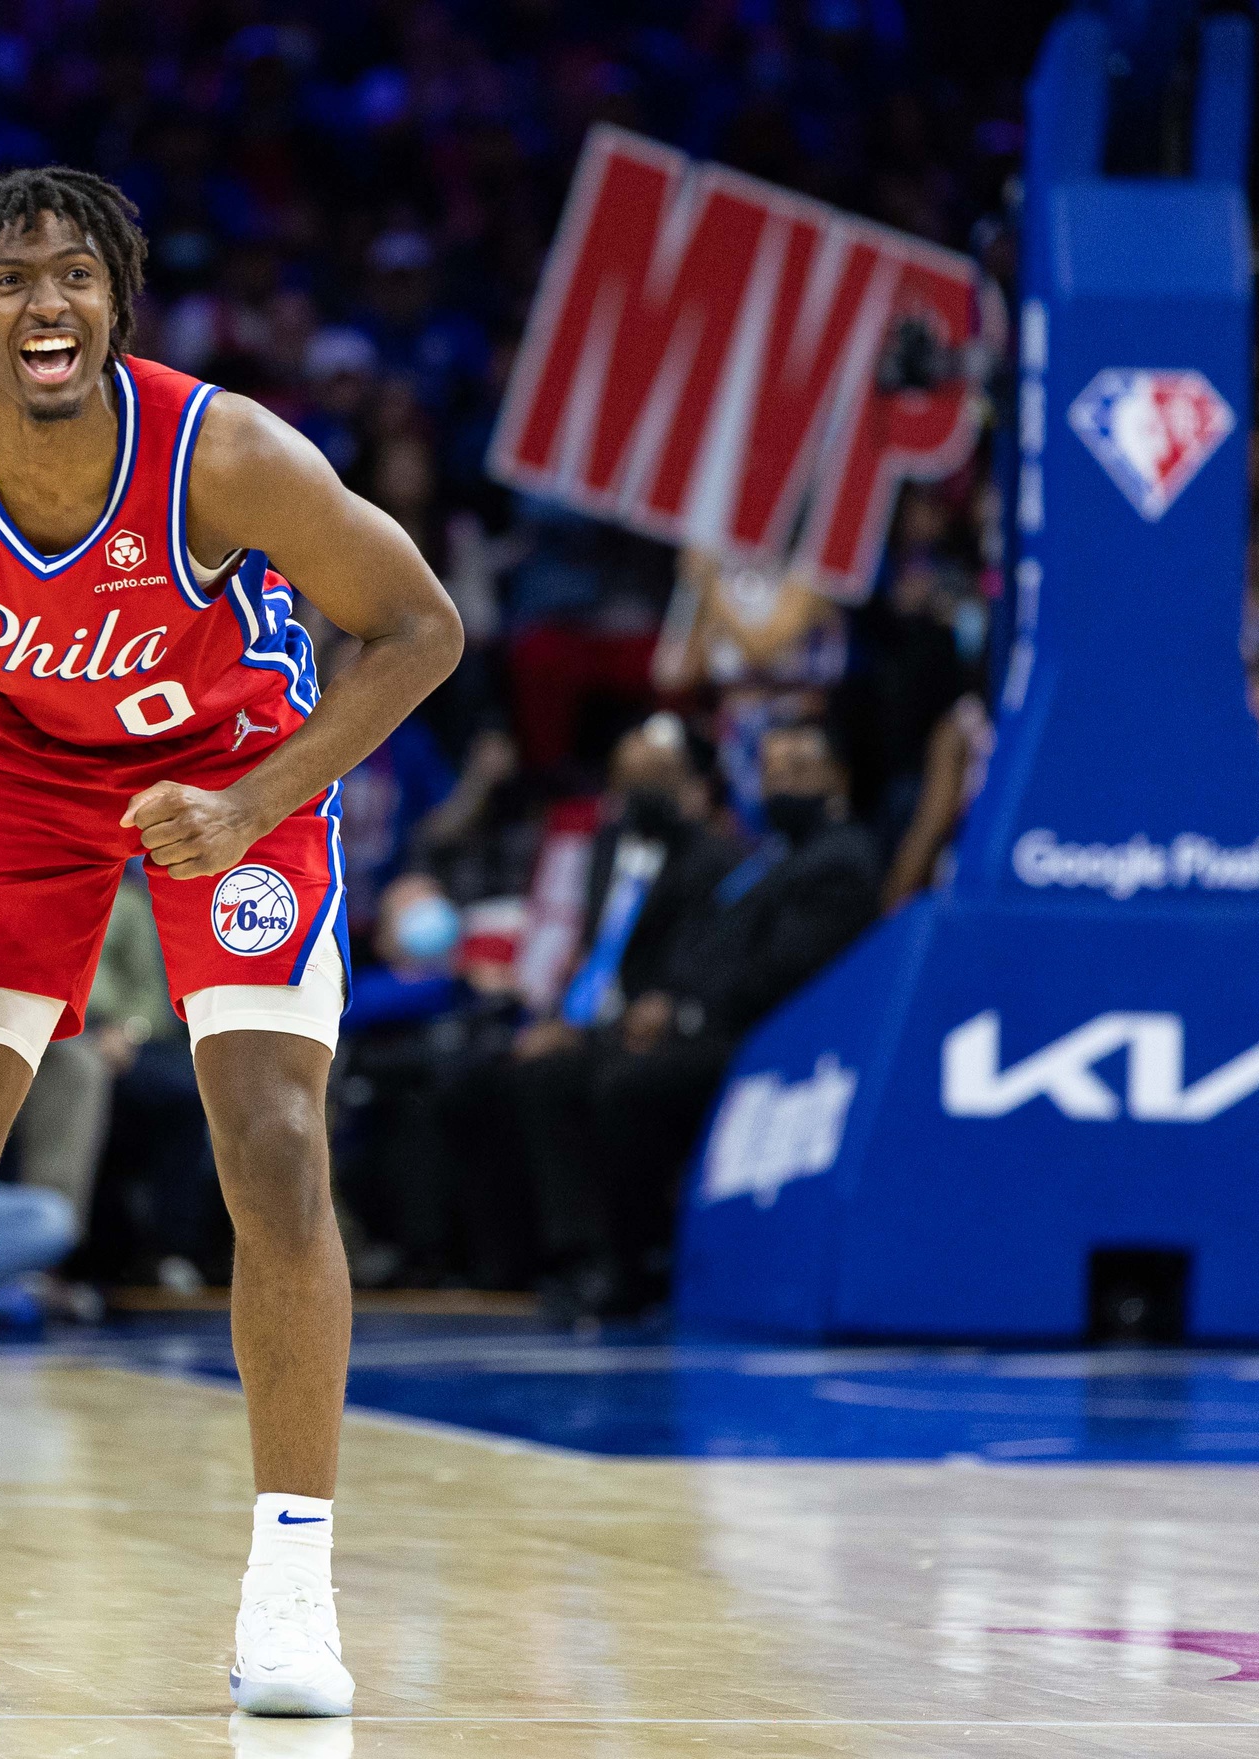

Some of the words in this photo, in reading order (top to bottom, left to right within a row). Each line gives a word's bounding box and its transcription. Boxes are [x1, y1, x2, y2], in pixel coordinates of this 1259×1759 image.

[508, 148, 986, 580] MVP
[94, 575, 168, 594] crypto.com
[114, 680, 196, 737] 0
[1012, 827, 1165, 900] Google
[220, 899, 288, 933] 76ers
